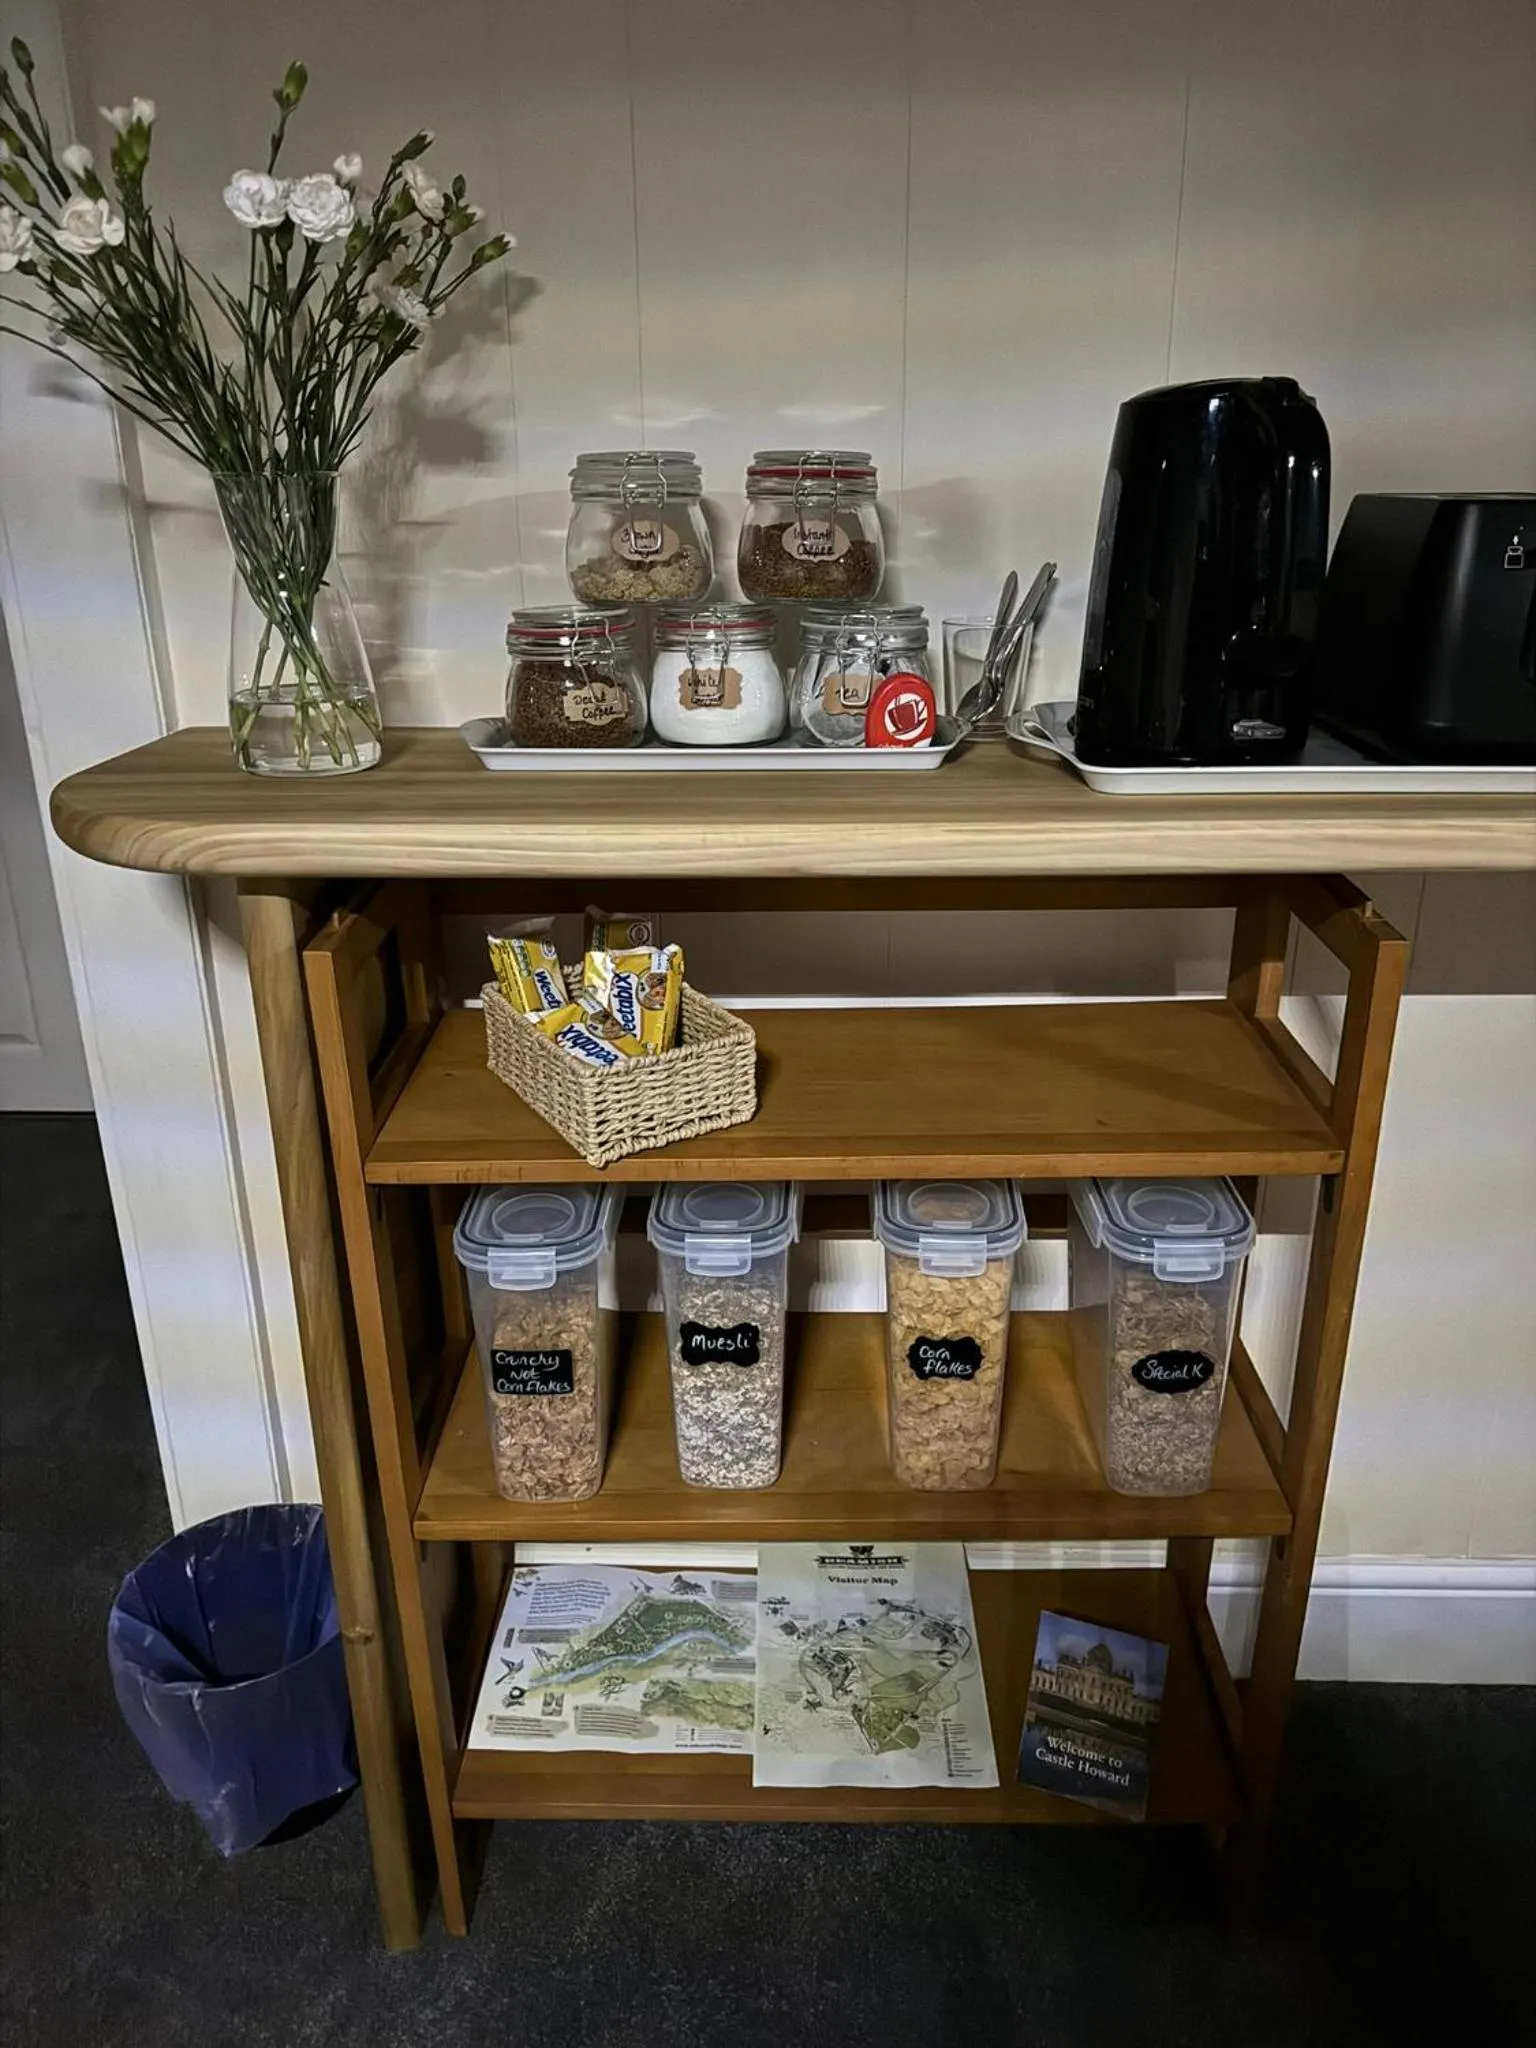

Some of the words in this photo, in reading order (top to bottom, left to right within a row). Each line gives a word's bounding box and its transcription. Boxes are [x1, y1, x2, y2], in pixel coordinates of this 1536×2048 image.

[607, 970, 638, 1038] eetabix
[556, 1024, 619, 1067] eetabix
[691, 1332, 752, 1351] Muesli
[495, 1352, 560, 1371] Crunchy
[919, 1345, 950, 1360] Corn
[1191, 1362, 1204, 1379] K
[827, 1575, 868, 1585] Visitor
[871, 1576, 899, 1586] Map
[1047, 1735, 1106, 1763] Welcome
[1108, 1757, 1122, 1769] to
[1035, 1747, 1075, 1769] Castle
[1077, 1760, 1130, 1787] Howard
